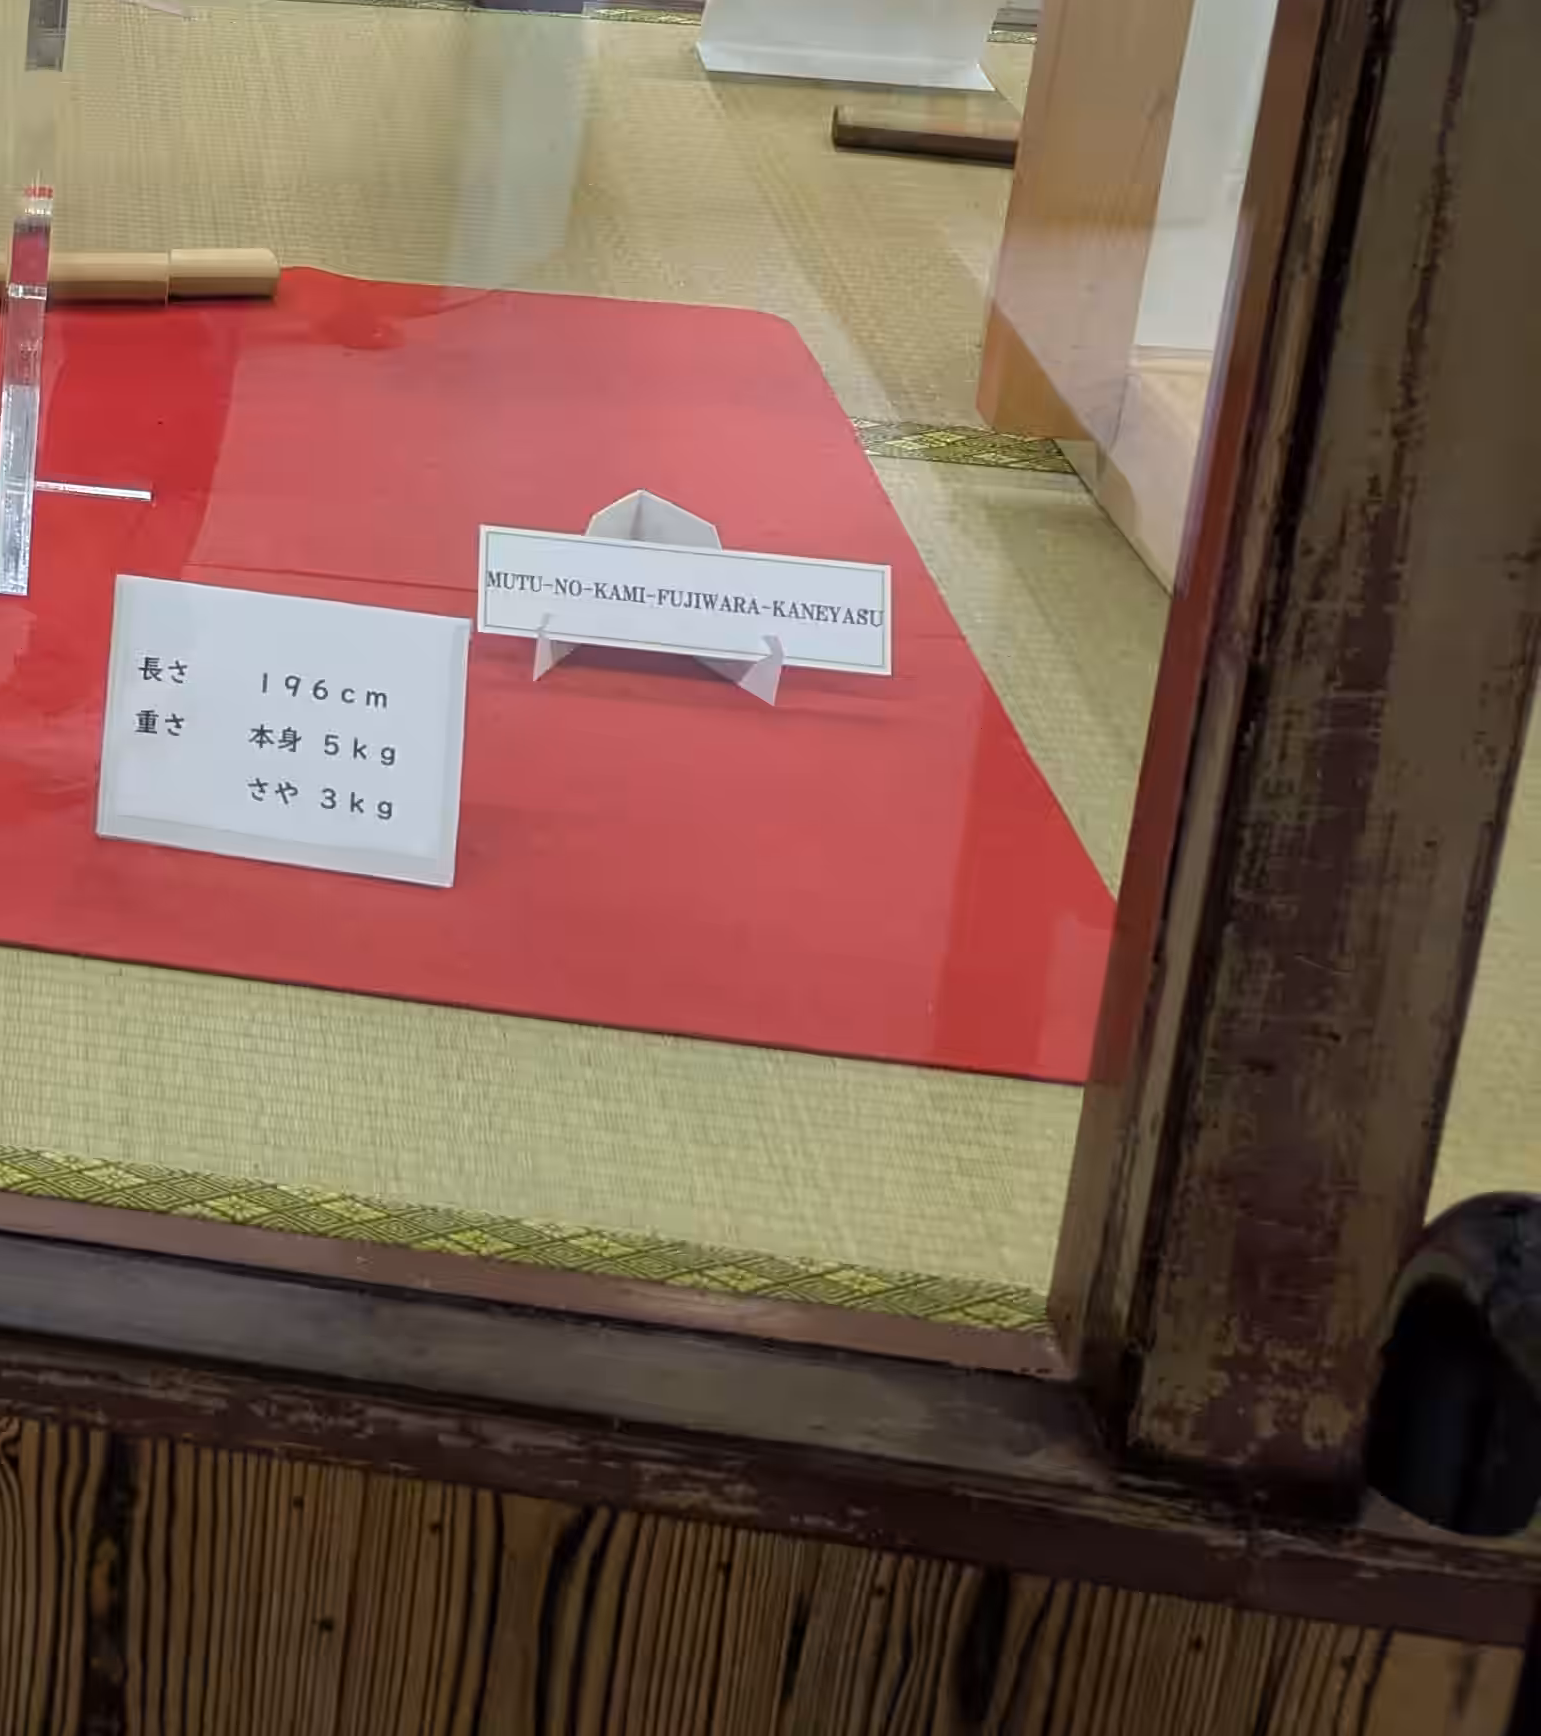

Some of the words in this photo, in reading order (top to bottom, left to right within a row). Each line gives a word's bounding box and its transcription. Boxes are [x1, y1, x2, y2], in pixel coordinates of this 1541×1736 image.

[487, 570, 884, 628] MUTU-NO-KAMI-FUJIWARA-KANEYASU
[137, 656, 188, 685] 長さ
[134, 709, 186, 737] 重さ
[247, 723, 303, 753] 本身
[246, 777, 299, 806] さや
